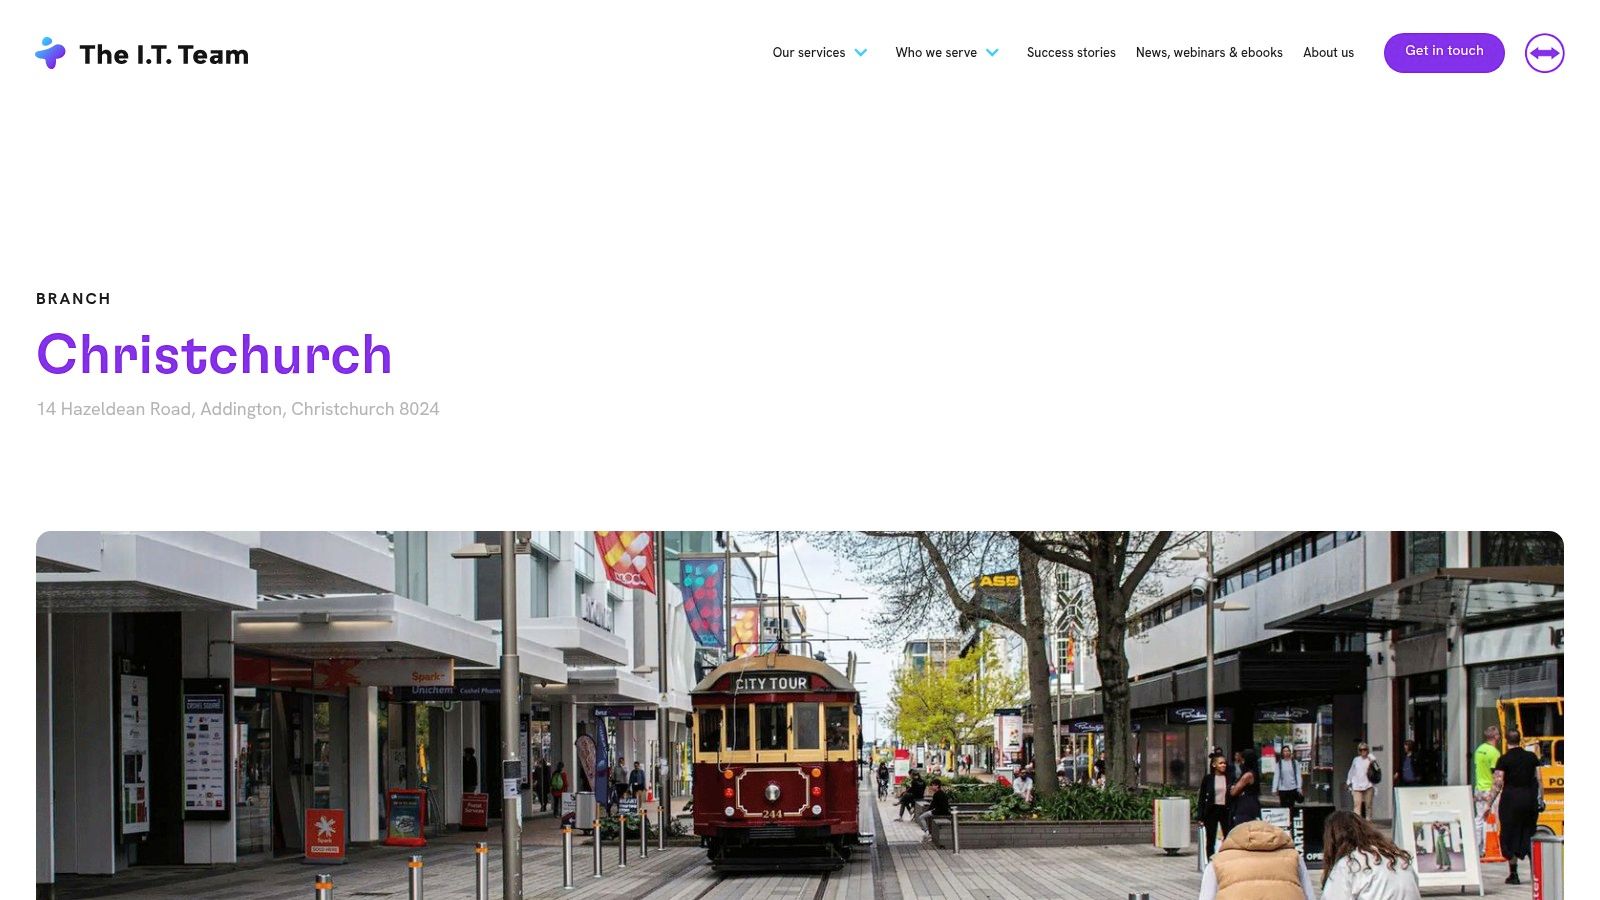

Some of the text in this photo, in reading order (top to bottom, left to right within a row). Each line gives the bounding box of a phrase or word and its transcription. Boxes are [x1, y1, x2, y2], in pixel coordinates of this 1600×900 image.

[411, 671, 441, 682] Spark
[735, 677, 807, 690] CITY TOUR
[412, 686, 453, 694] Unichem
[763, 810, 782, 818] 244
